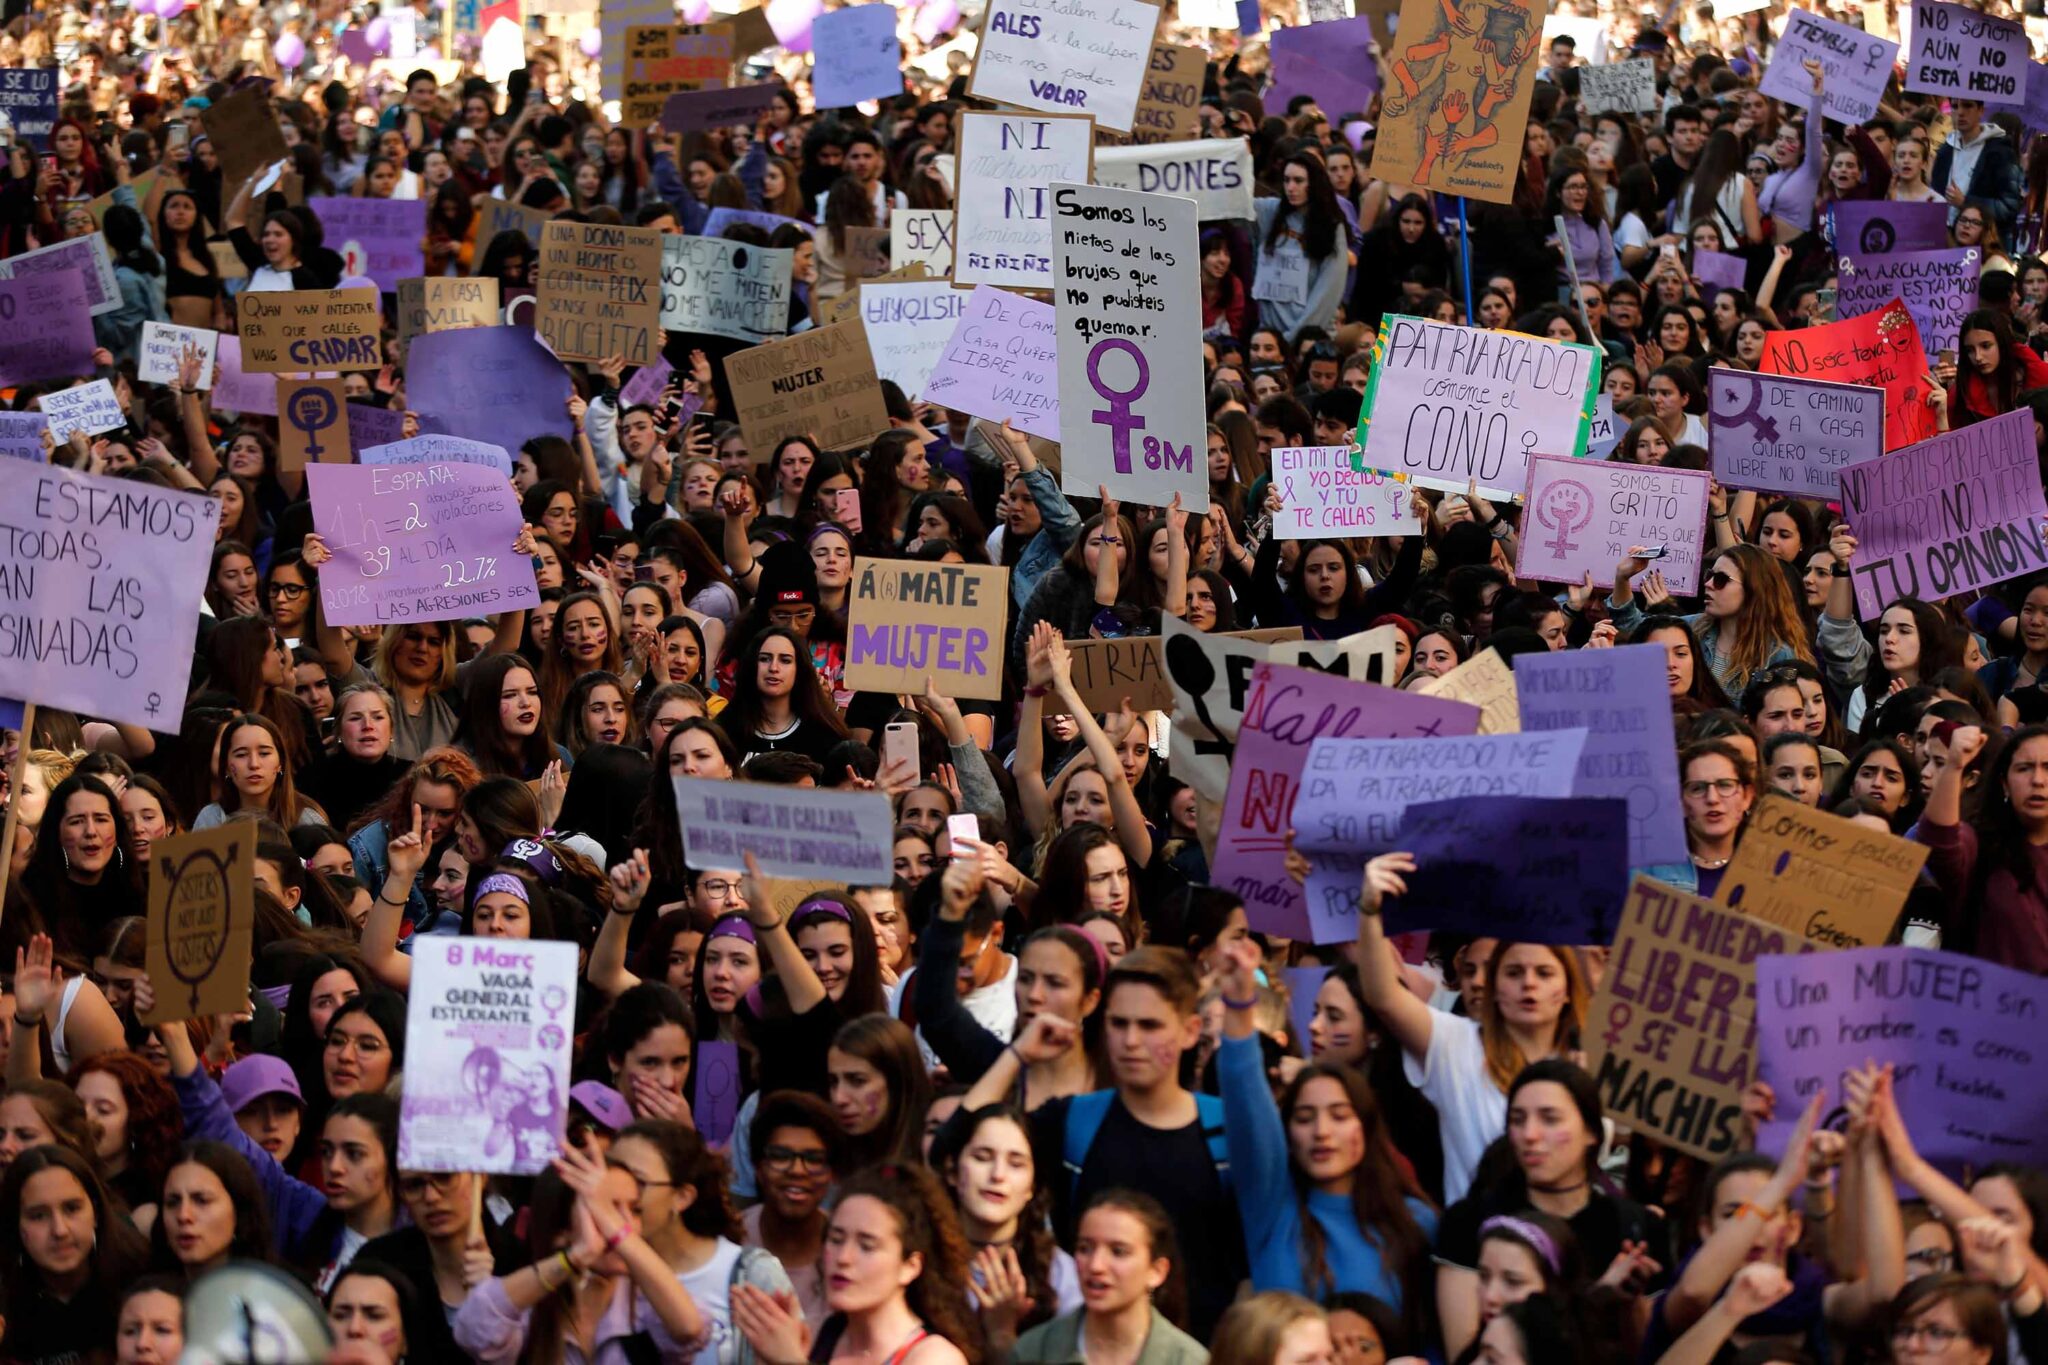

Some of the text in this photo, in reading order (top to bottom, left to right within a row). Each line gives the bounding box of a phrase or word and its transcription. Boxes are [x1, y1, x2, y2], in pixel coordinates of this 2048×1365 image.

[991, 11, 1042, 39] ALES
[1920, 7, 1949, 31] NO
[1019, 58, 1049, 72] no
[1922, 37, 2006, 68] AÚN NO
[5, 73, 49, 90] SE LO
[1030, 79, 1088, 108] VOLAR
[1920, 63, 2016, 96] ESTÁ HECHO
[1001, 121, 1051, 150] NI
[1139, 160, 1241, 192] DONES
[1004, 187, 1048, 219] NI
[1055, 189, 1167, 231] Somos las
[551, 226, 576, 242] UNA
[584, 227, 625, 247] DONA
[1064, 230, 1175, 266] nietas de las
[549, 250, 617, 271] UN HOME
[1065, 256, 1158, 292] brujas que
[1853, 260, 1963, 281] MARCHAMOS
[546, 269, 582, 293] COM
[610, 275, 647, 303] PEIX
[696, 271, 723, 296] ME
[1838, 276, 1978, 300] PORQUE ESTAMOS
[294, 304, 319, 315] VAN
[326, 303, 376, 316] INTENTAR
[550, 298, 625, 319] SENSE UNA
[984, 298, 1009, 321] DE
[1066, 289, 1165, 311] no pudisteis
[244, 325, 266, 337] FER
[282, 326, 307, 337] QUE
[962, 325, 999, 350] CASA
[1075, 317, 1156, 344] quemar.
[252, 335, 378, 366] VAIG CRIDAR
[1387, 322, 1577, 400] PATRIARCADO,
[1771, 339, 1809, 374] NO
[1853, 339, 1887, 363] teva
[948, 347, 1016, 377] LIBRE,
[1023, 371, 1044, 384] NO
[772, 366, 825, 394] MUJER
[1423, 377, 1520, 410] cómeme el
[834, 406, 849, 420] la
[1770, 387, 1864, 414] DE CAMINO
[1790, 415, 1864, 438] A CASA
[1143, 437, 1192, 474] 8M
[1403, 404, 1508, 481] COÑO
[1752, 441, 1850, 466] QUIERO SER
[1309, 471, 1331, 488] YO
[1609, 473, 1689, 495] SOMOS EL
[1727, 458, 1767, 480] LIBRE
[1779, 466, 1794, 482] NO
[1318, 487, 1358, 506] Y TÚ
[1610, 491, 1678, 520] GRITO
[1840, 468, 1868, 517] NO
[36, 478, 196, 542] ESTAMOS
[405, 502, 428, 531] 2
[1322, 506, 1376, 527] CALLAS
[1941, 481, 1972, 538] NO
[1608, 520, 1696, 544] DE LAS QUE
[360, 546, 392, 577] 39
[425, 536, 457, 560] DÍA
[1606, 541, 1622, 557] YA
[326, 584, 371, 610] 2018
[440, 557, 497, 588] 22.7%
[1855, 551, 1921, 612] TU
[88, 576, 145, 620] LAS
[376, 603, 410, 620] LAS
[417, 588, 502, 613] AGRESIONES
[851, 623, 990, 677] MUJER
[1344, 742, 1497, 771] PATRIARCADO
[1507, 739, 1554, 769] ME
[1309, 778, 1338, 799] DA
[1634, 882, 1786, 966] TU MIEDO
[447, 945, 536, 971] 8 Març
[481, 974, 533, 989] VAGA
[1774, 958, 2037, 1018] Una MUJER sin
[446, 989, 532, 1007] GENERAL
[1633, 1019, 1679, 1063] SE
[1785, 1024, 1820, 1050] un
[1936, 1027, 1960, 1047] es
[1974, 1039, 2033, 1065] como
[1794, 1075, 1822, 1097] un
